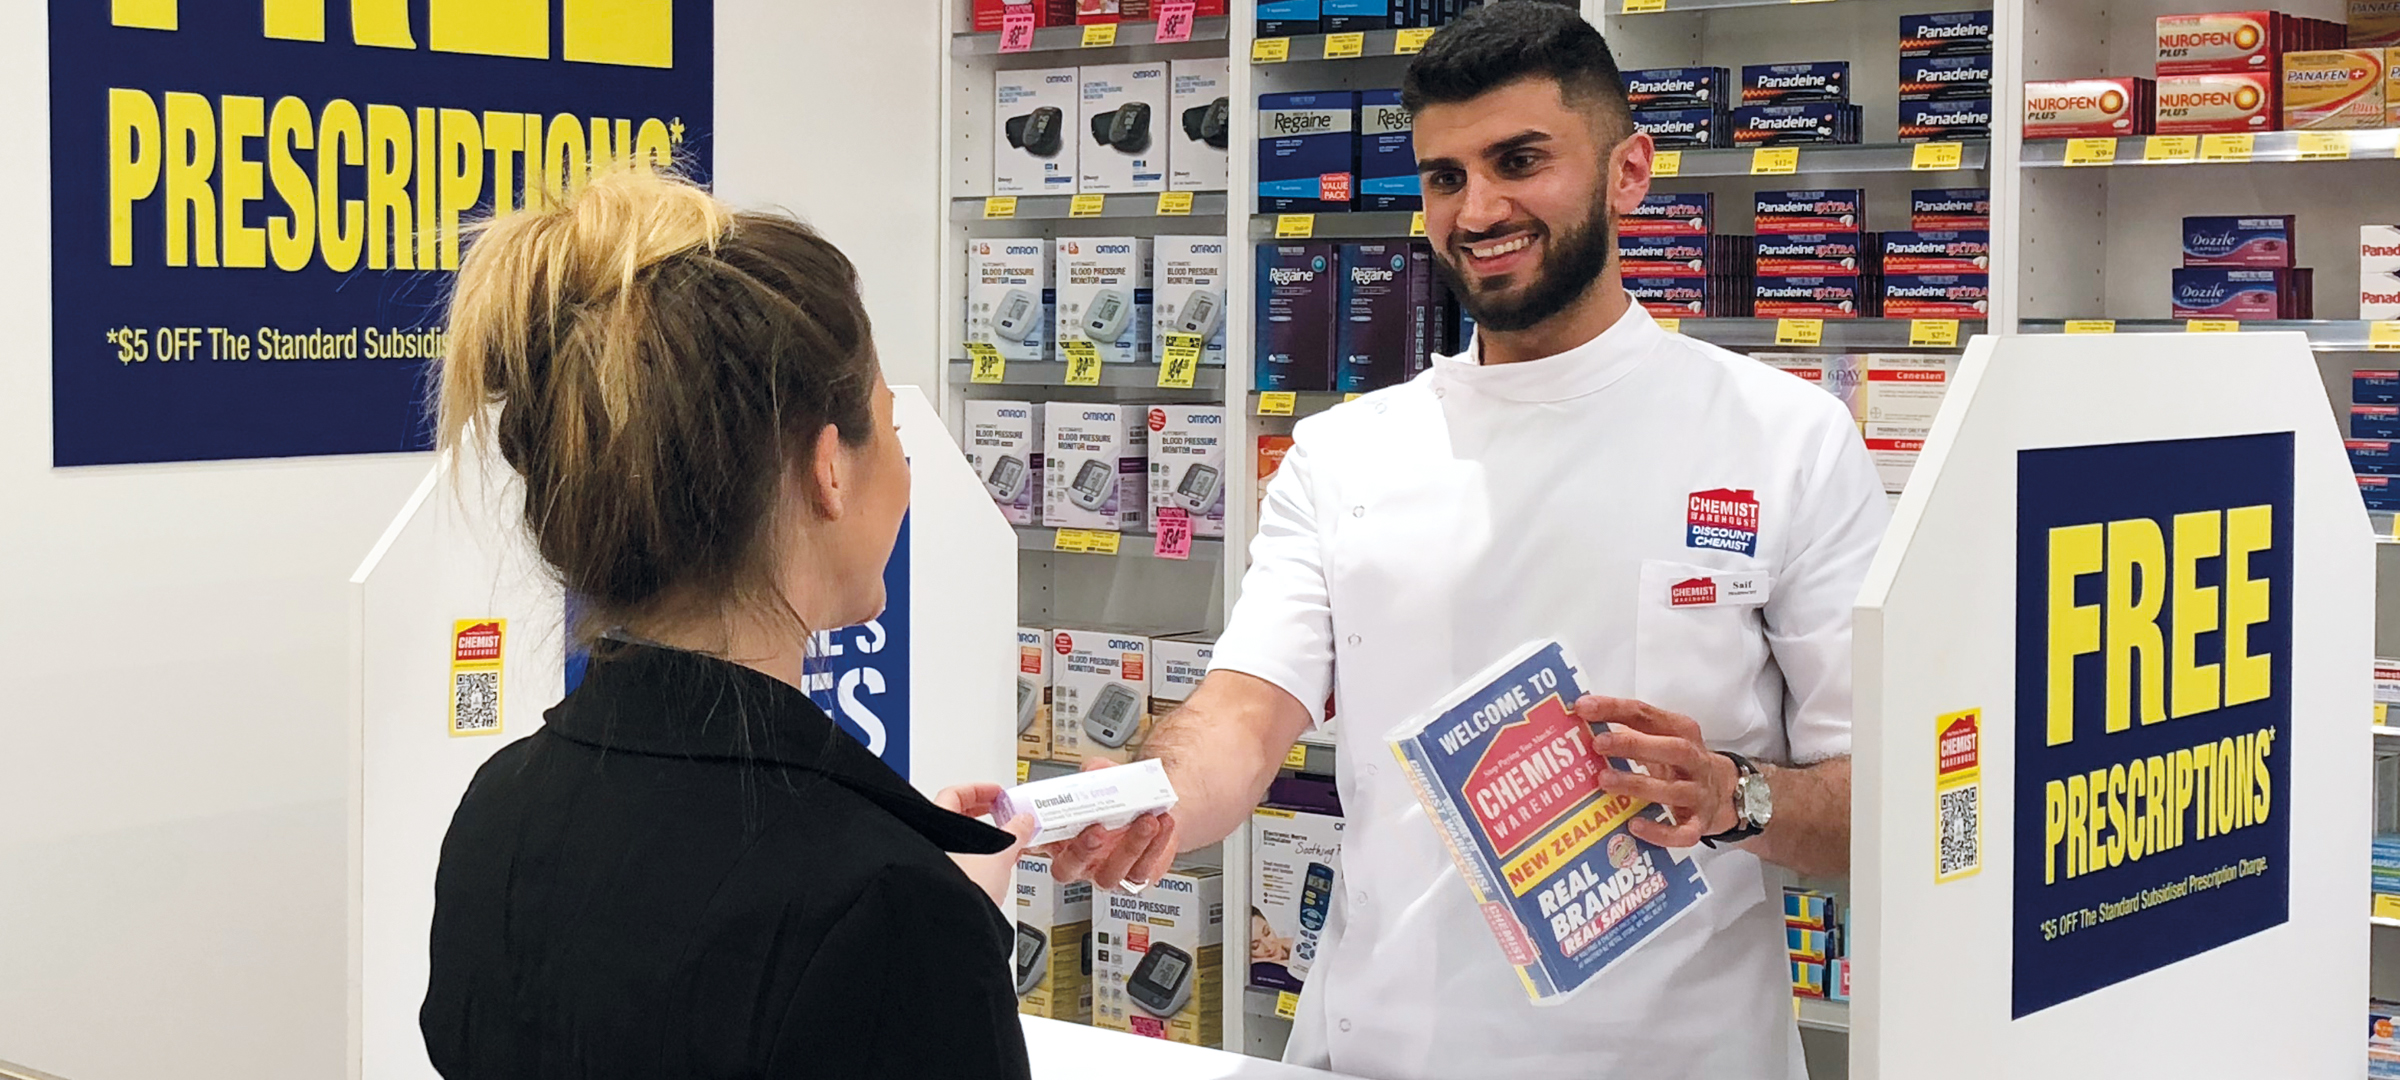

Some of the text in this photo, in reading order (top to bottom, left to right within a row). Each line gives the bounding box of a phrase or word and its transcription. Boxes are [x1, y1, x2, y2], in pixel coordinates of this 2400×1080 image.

[2352, 2, 2400, 12] PANAFE
[1917, 24, 1988, 38] Panadeine
[2159, 32, 2232, 48] NUROFEN
[2159, 48, 2188, 57] PLUS
[1046, 75, 1072, 84] OMRON
[1132, 70, 1161, 78] OMRON
[1758, 74, 1826, 88] Panadeine
[1916, 68, 1988, 82] Panadeine
[2288, 70, 2348, 81] PANAFEN
[1630, 79, 1694, 92] Panadeine
[2028, 96, 2096, 110] NUROFEN
[2159, 92, 2232, 108] NUROFEN
[1378, 108, 1412, 130] Rega
[1916, 112, 1988, 126] Panadeine
[2028, 112, 2056, 120] PLUS
[2159, 108, 2188, 117] PLUS
[1274, 112, 1331, 134] Regaine
[1750, 116, 1818, 130] Panadeine
[1322, 182, 1348, 190] VALUE
[1324, 191, 1346, 200] PACK
[1757, 202, 1854, 215] Panadeine EXTRA
[1914, 201, 1973, 212] Panadeine
[2192, 230, 2236, 246] Dozile
[1006, 246, 1038, 255] OMRON
[1096, 244, 1130, 254] OMRON
[1190, 244, 1222, 254] OMRON
[1619, 246, 1664, 256] anadeine
[1758, 244, 1854, 257] Panadeine EXTRA
[1886, 242, 1946, 254] Panadeine
[1070, 268, 1126, 276] BLOOD PRESSURE
[1270, 268, 1313, 284] Regaine
[1352, 267, 1392, 284] Regaine
[1757, 286, 1853, 300] Panadeine EXTRA
[1887, 286, 1946, 296] Panadeine
[2182, 282, 2224, 297] Dozile
[156, 328, 201, 360] OFF
[208, 327, 249, 360] The
[257, 327, 357, 360] Standard
[364, 326, 450, 360] Subsidis
[1896, 372, 1942, 380] Canesten
[997, 410, 1026, 418] OMRON
[1082, 412, 1116, 421] OMRON
[1188, 415, 1221, 424] OMRON
[995, 431, 1023, 439] PRESSURE
[1058, 434, 1111, 442] BLOOD PRESSURE
[1185, 438, 1218, 446] PRESSURE
[1058, 442, 1086, 450] MONITOR
[1894, 440, 1924, 449] Canes
[1690, 496, 1758, 518] CHEMIST
[1690, 512, 1756, 528] WAREHOUSE
[1692, 526, 1754, 542] DISCOUNT
[1694, 536, 1749, 552] CHEMIST
[1672, 586, 1714, 597] CHEMIST
[1732, 580, 1752, 589] Saif
[2046, 504, 2272, 746] FREE
[458, 635, 500, 648] CHEMIST
[1108, 640, 1144, 650] OMRON
[1068, 664, 1095, 672] MONITOR
[1090, 657, 1120, 667] PRESSURE
[1166, 666, 1186, 674] BLOOD
[1438, 667, 1558, 756] WELCOME TO
[1940, 733, 1977, 758] CHEMIST
[1476, 726, 1590, 820] CHEMIST
[1035, 793, 1074, 809] DermAid
[1492, 762, 1598, 839] WAREHOUSE
[1408, 756, 1493, 898] CHEMIST WAREHOUSE
[1508, 794, 1632, 889] NEW ZEALAND
[1295, 842, 1336, 864] Soothing
[1017, 860, 1047, 874] MRON
[1537, 861, 1600, 919] REAL
[1550, 850, 1656, 943] BRANDS!
[2060, 912, 2078, 936] OFF
[2080, 908, 2097, 929] The
[2099, 892, 2140, 923] Standard
[2142, 878, 2188, 910] Subsidised
[2189, 865, 2238, 894] Prescription
[2238, 856, 2268, 878] Charge.
[1110, 897, 1180, 916] BLOOD PRESSURE
[1110, 908, 1146, 922] MONITOR
[1564, 920, 1602, 955] REAL
[1602, 873, 1664, 928] SAVINGS!
[1487, 901, 1528, 965] CHEMIST
